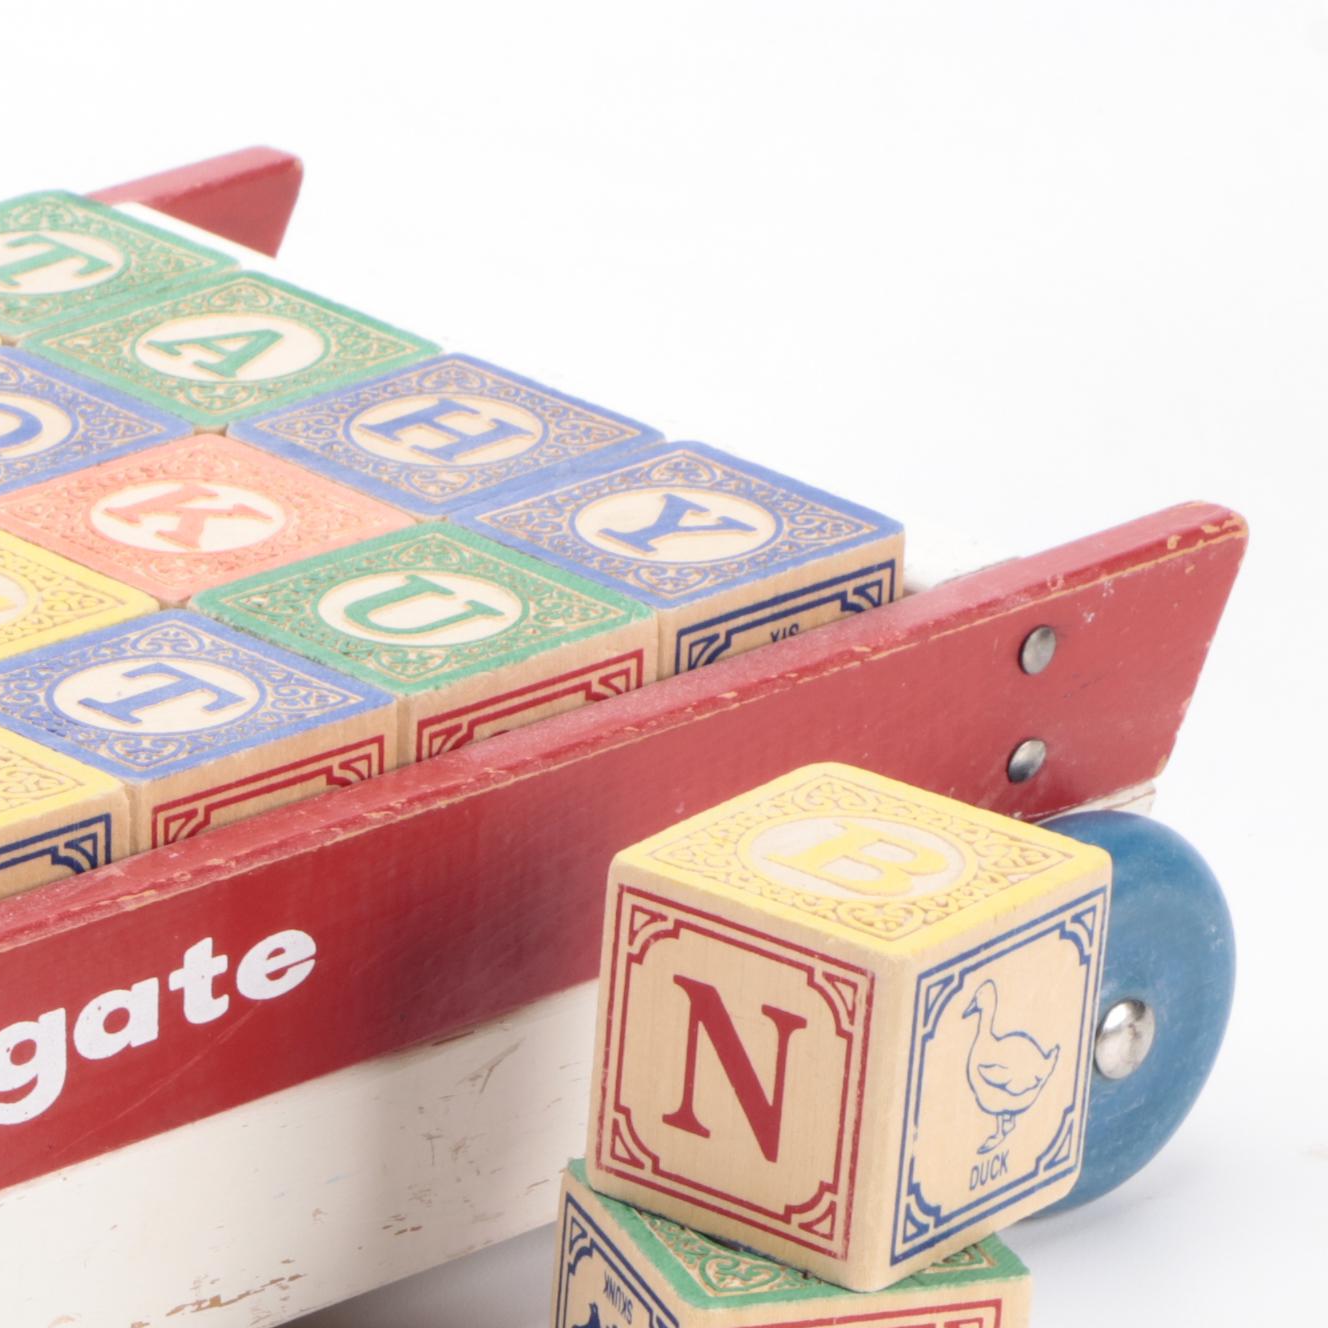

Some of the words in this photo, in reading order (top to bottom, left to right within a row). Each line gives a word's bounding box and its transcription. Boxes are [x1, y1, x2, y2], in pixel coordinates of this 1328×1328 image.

[147, 329, 283, 376] A
[363, 399, 532, 462] H
[103, 483, 269, 549] K
[600, 493, 755, 553] Y
[344, 575, 505, 640] U
[78, 664, 246, 724] T
[766, 822, 942, 896] B
[662, 975, 807, 1162] N
[969, 1148, 1009, 1191] DUCK
[602, 1268, 634, 1327] SKUNK
